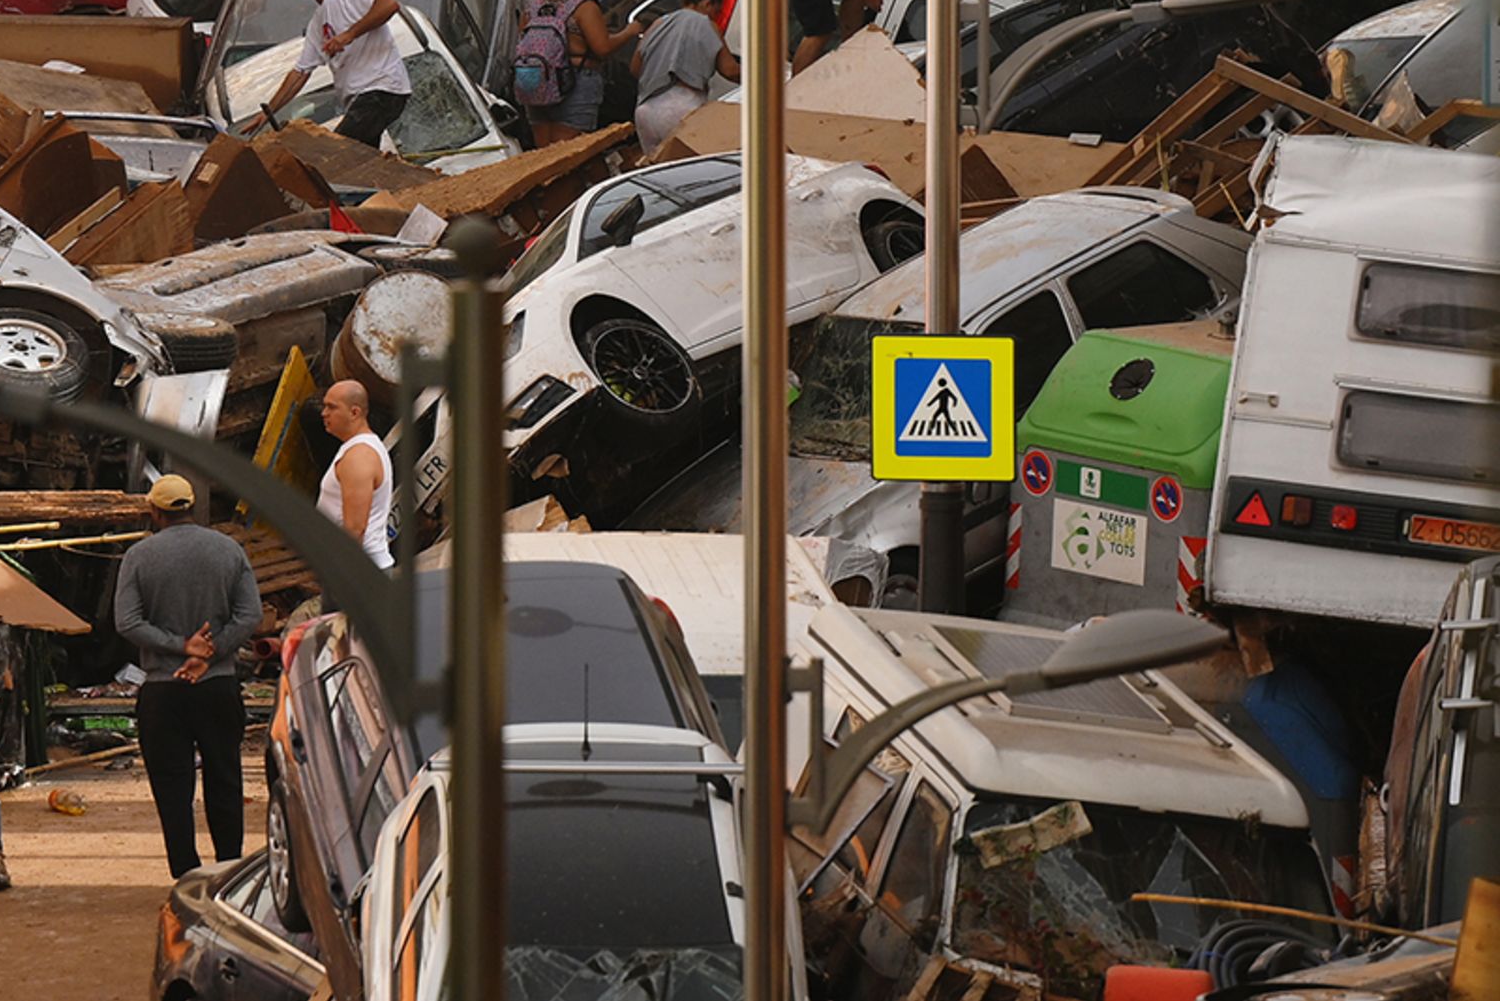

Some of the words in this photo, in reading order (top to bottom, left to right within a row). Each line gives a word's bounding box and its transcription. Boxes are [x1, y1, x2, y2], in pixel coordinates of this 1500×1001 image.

[416, 456, 447, 490] LFR
[1098, 511, 1136, 526] ALFAFAR
[1110, 541, 1136, 558] TOTS
